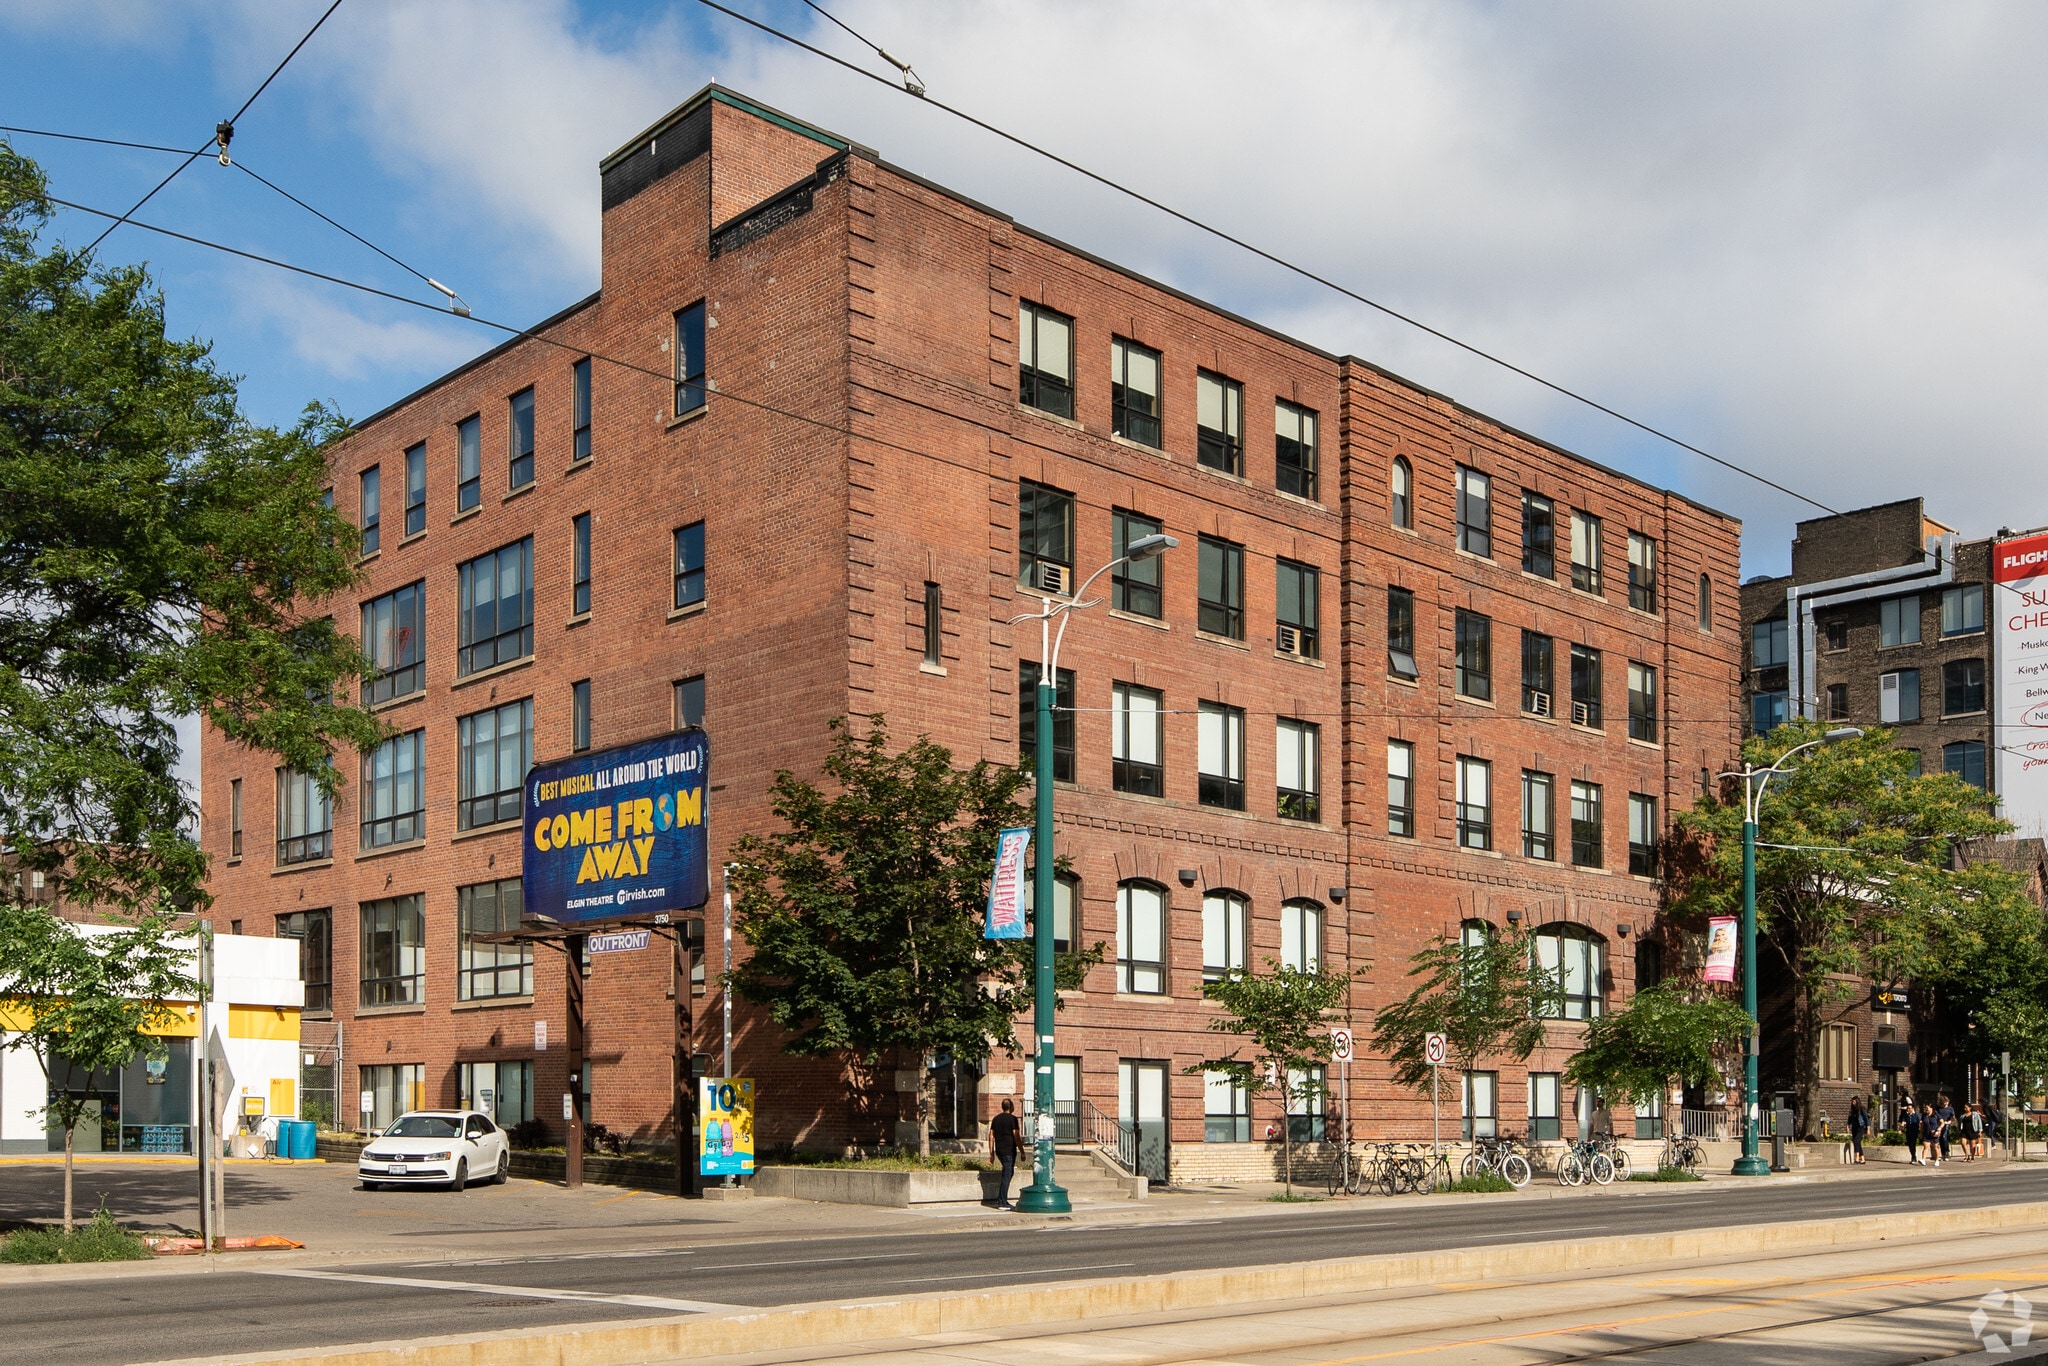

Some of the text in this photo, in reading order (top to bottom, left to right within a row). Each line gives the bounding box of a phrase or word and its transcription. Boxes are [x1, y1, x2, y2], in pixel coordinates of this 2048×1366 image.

[2022, 589, 2046, 607] SU
[2009, 611, 2048, 631] CHE
[2018, 666, 2038, 675] King
[540, 750, 696, 802] BEST MUSICAL ALL AROUND THE WORLD
[534, 806, 612, 852] COME
[576, 836, 655, 884] AWAY
[992, 836, 1023, 927] WAITRESS
[567, 899, 585, 909] ELGIN
[586, 895, 614, 906] THEATRE
[655, 914, 668, 924] 3750
[591, 932, 648, 950] OUTFRONT
[707, 1085, 736, 1112] 10
